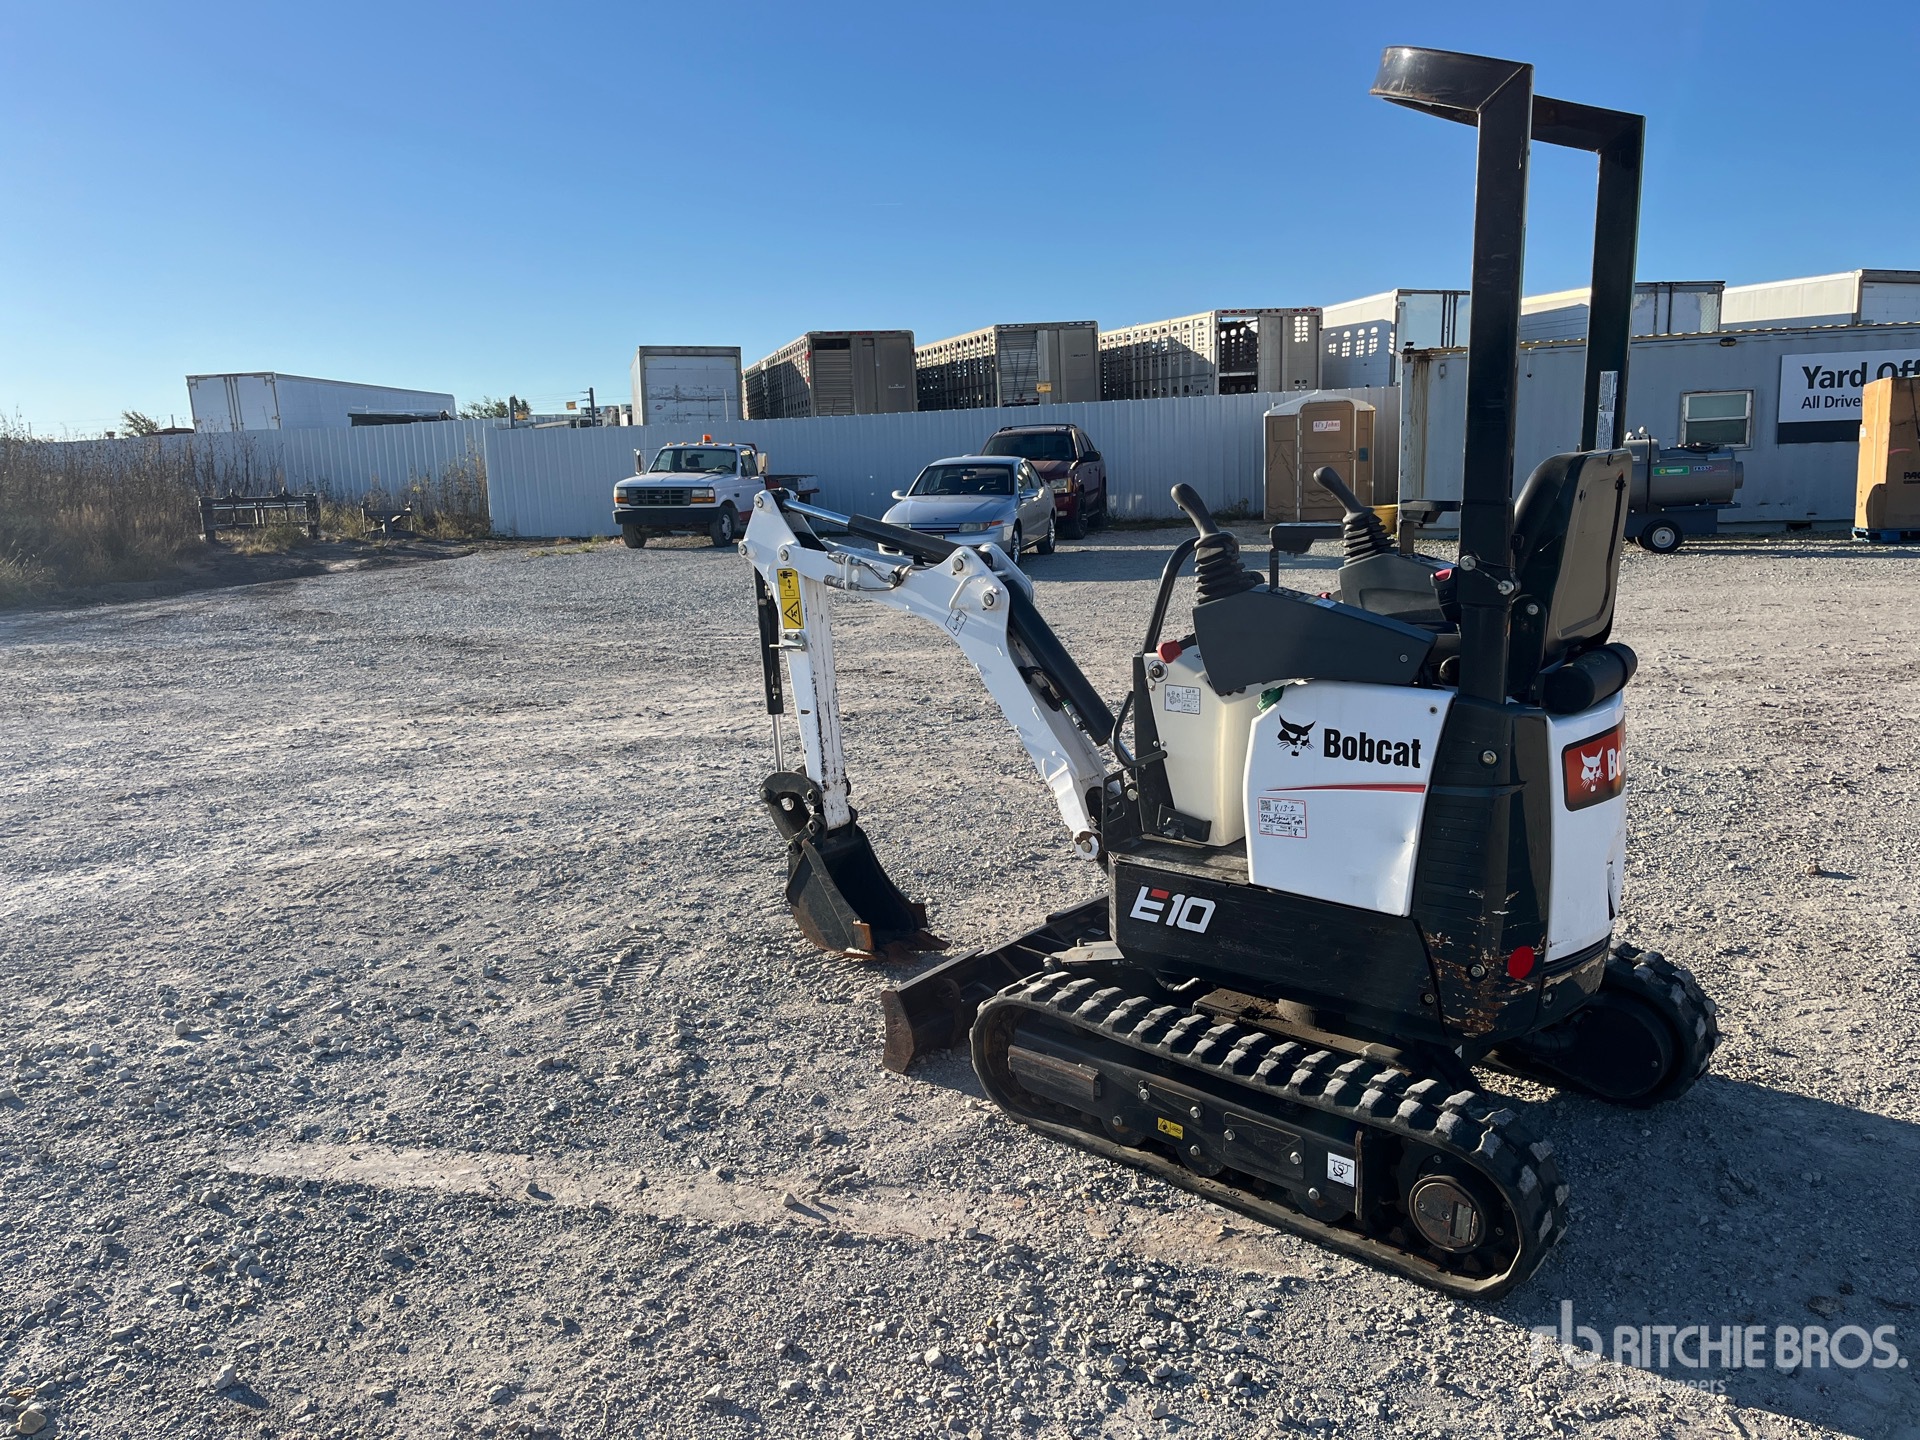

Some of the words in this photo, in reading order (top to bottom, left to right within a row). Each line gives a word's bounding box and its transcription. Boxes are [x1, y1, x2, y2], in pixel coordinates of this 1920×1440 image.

[1802, 362, 1868, 389] Yard
[1801, 396, 1820, 409] All
[1824, 395, 1862, 408] Drive
[1323, 728, 1421, 769] Bobcat
[1130, 886, 1216, 934] E10
